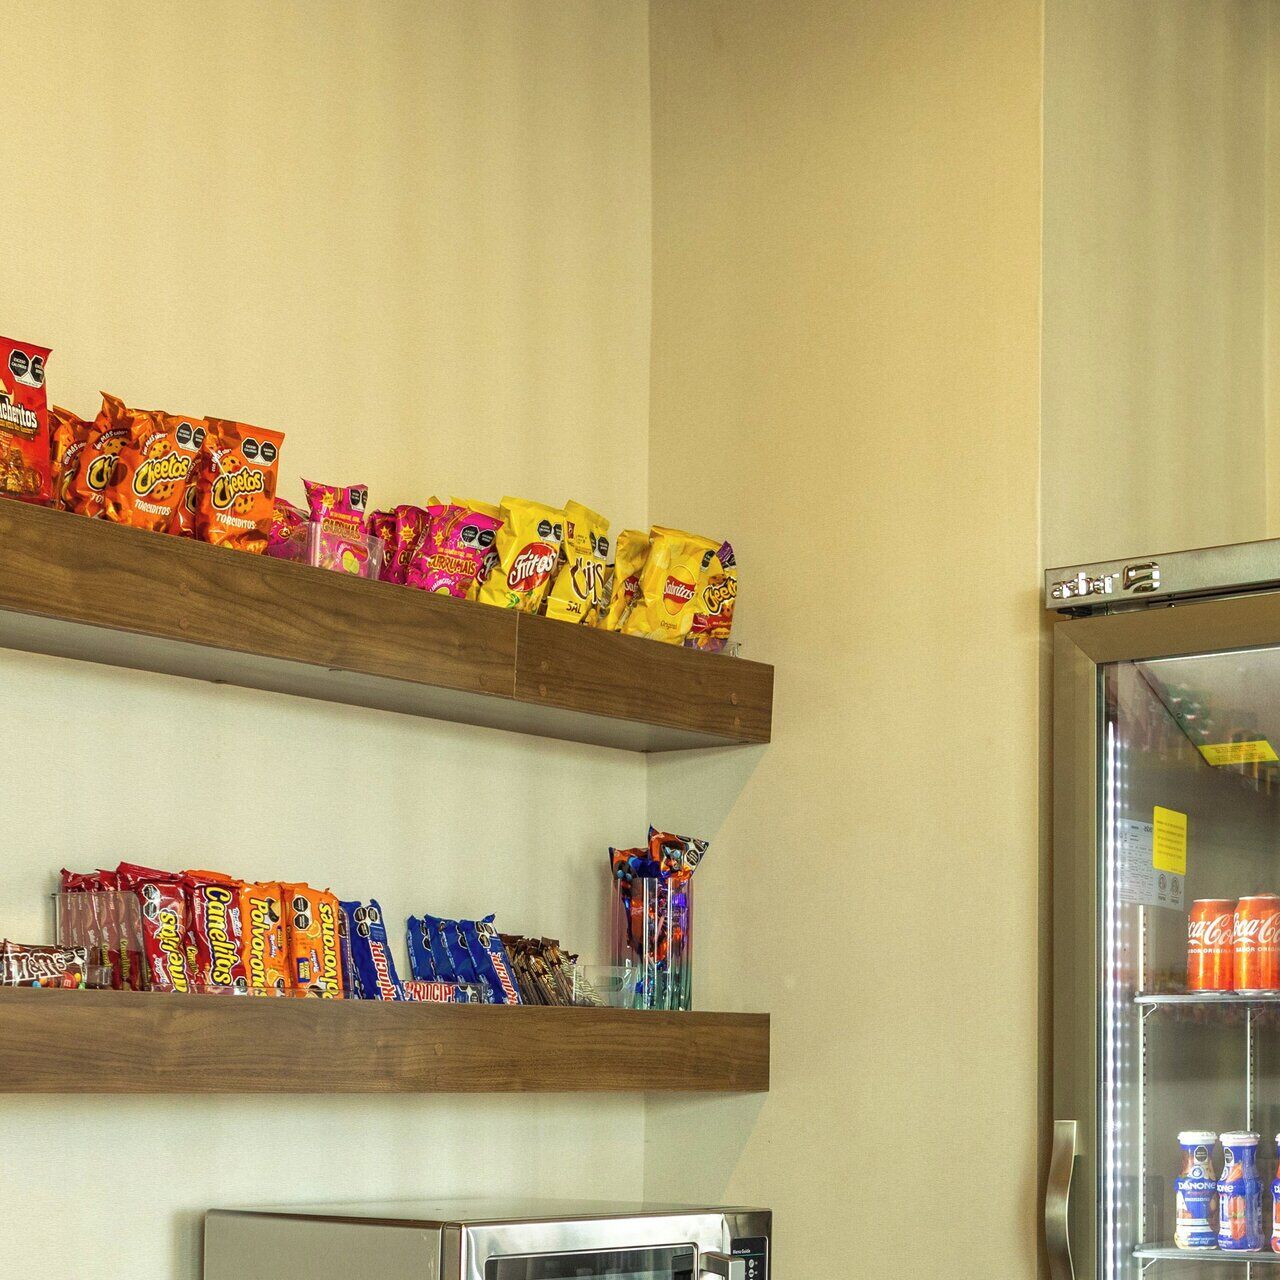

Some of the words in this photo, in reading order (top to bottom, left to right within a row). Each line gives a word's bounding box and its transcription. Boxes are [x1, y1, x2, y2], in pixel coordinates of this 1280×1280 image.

[134, 452, 190, 496] Cheetos
[213, 468, 263, 510] Cheetos
[135, 499, 172, 516] TORCIDITOS
[216, 512, 256, 530] TORCIDITOS
[509, 548, 556, 587] Fritos
[663, 576, 695, 601] Sabritas
[566, 600, 582, 614] SAL
[206, 886, 240, 986] Canelitas
[249, 897, 271, 997] Polvorones
[1178, 1181, 1217, 1191] DANONE
